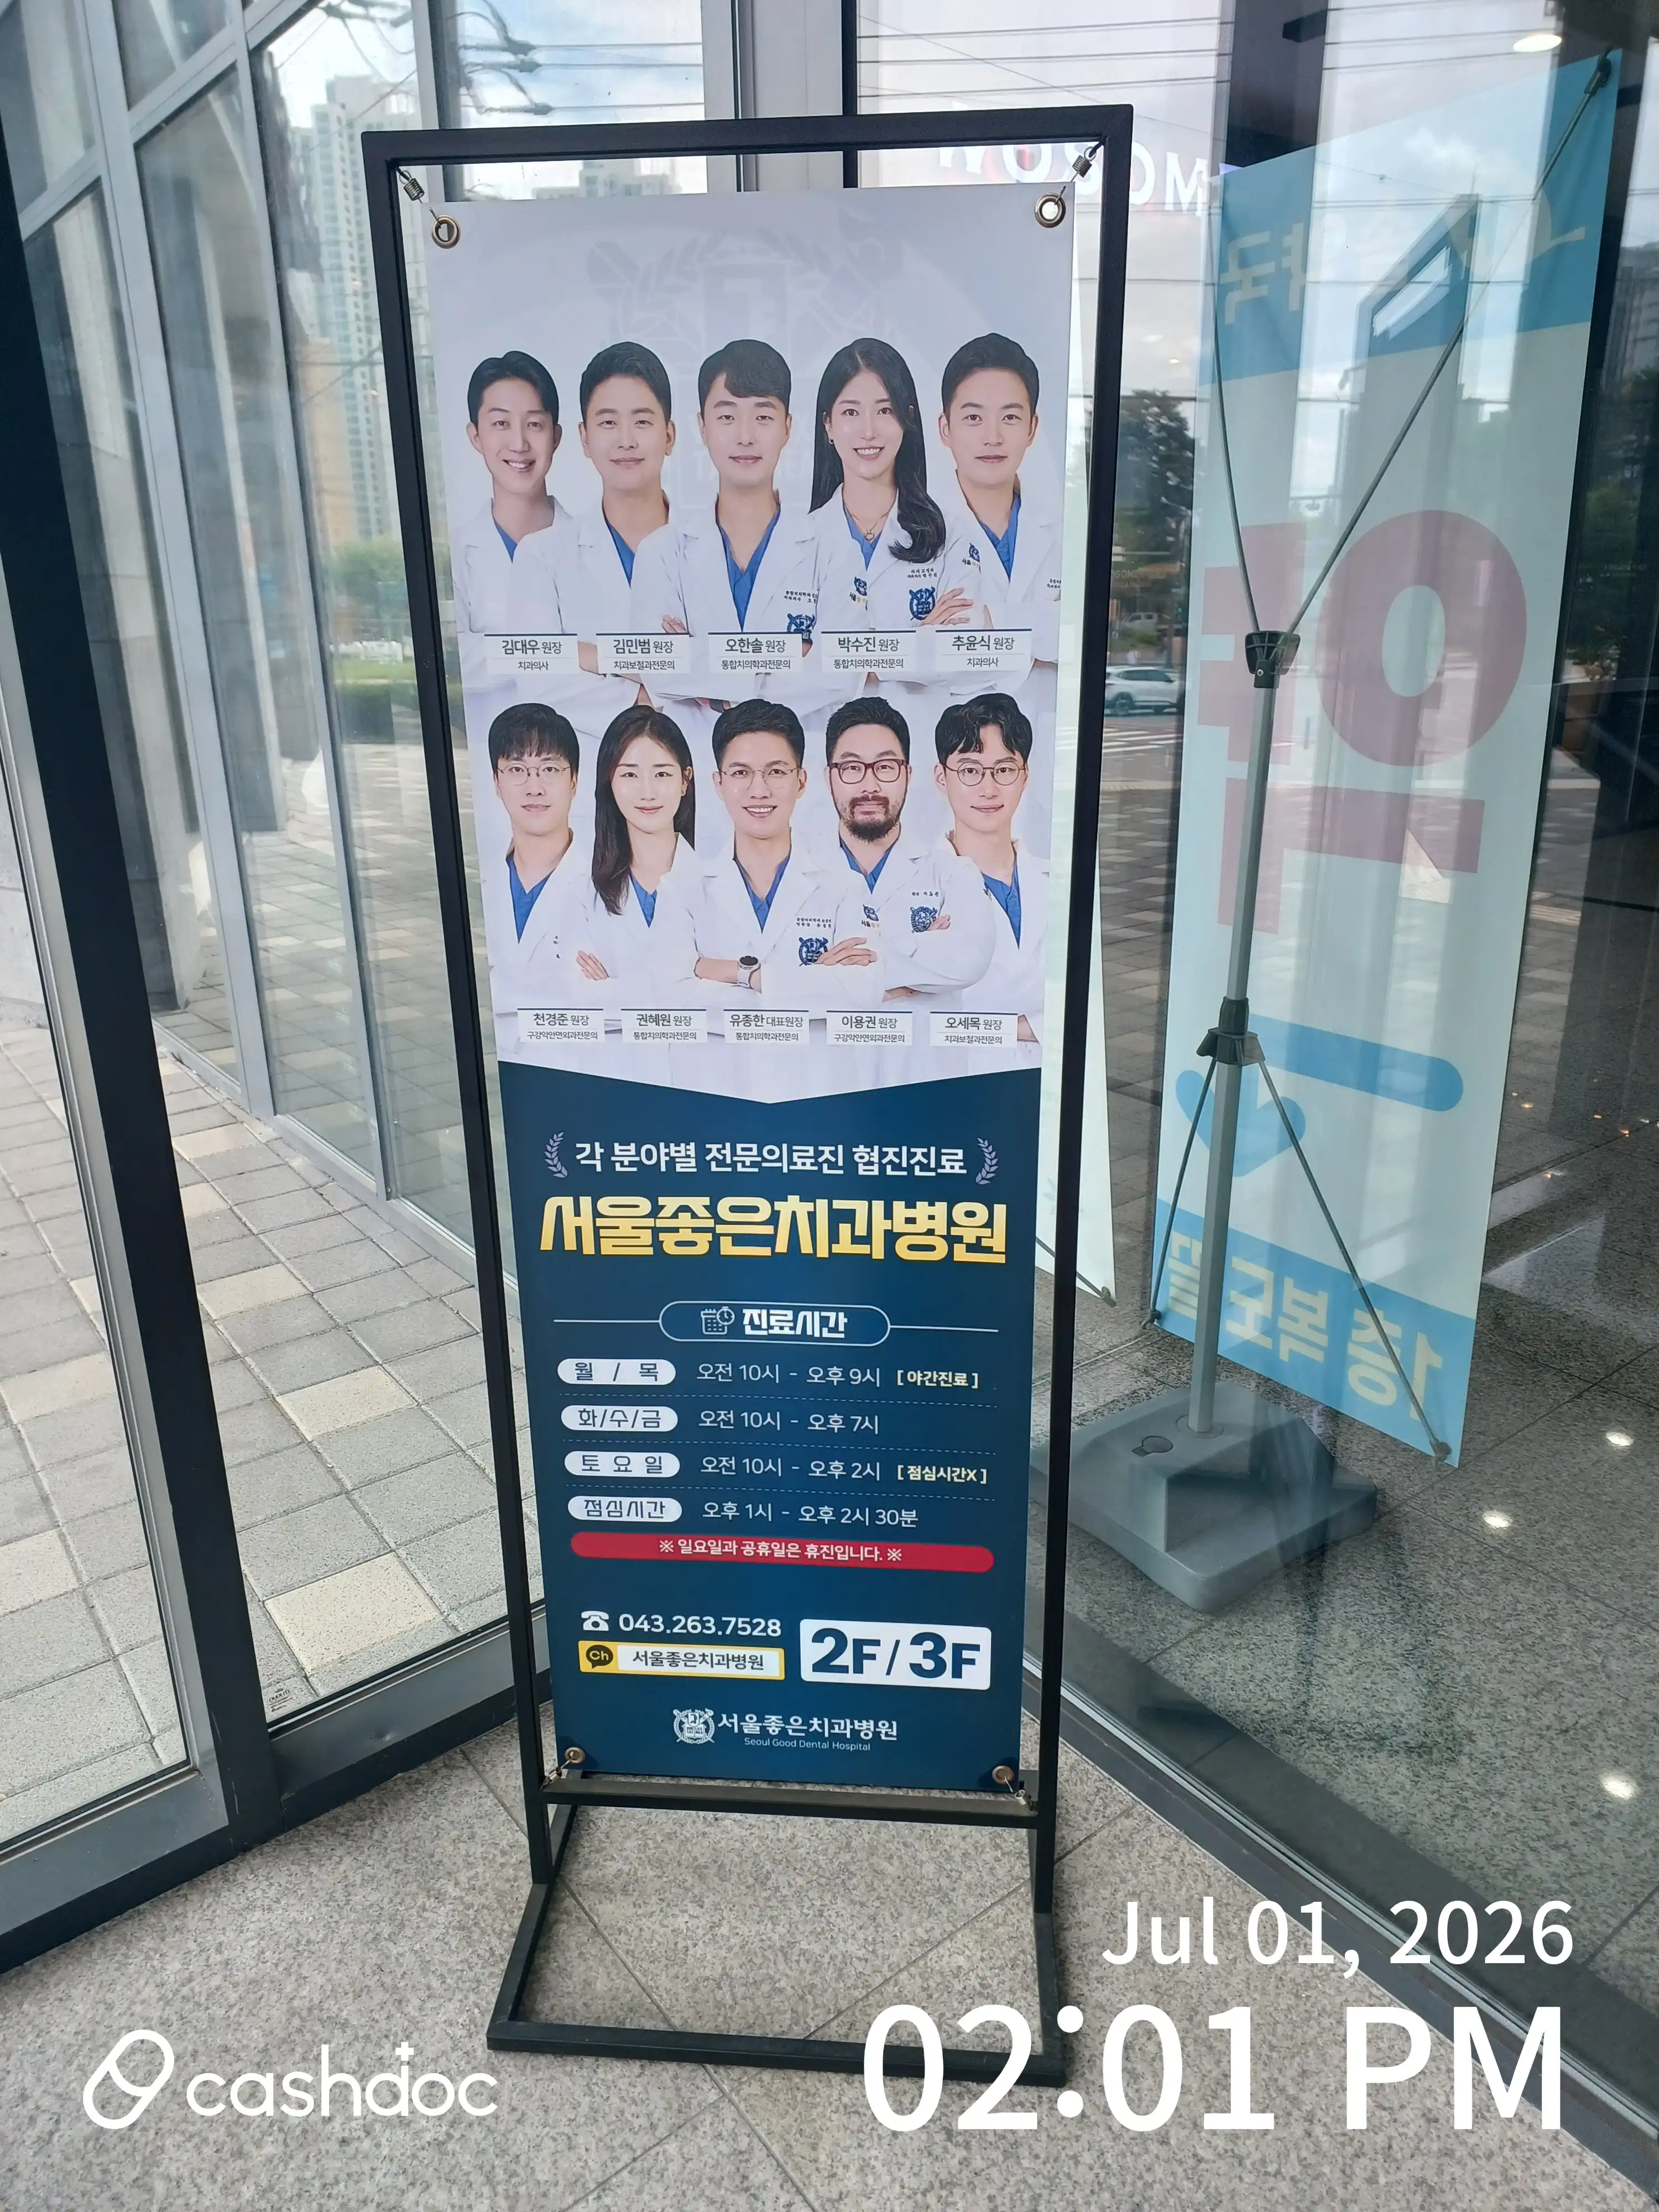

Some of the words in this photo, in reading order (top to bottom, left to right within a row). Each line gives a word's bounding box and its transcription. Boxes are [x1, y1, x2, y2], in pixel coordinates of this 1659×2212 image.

[503, 639, 540, 654] 김대우
[541, 642, 562, 654] 원장
[614, 639, 650, 654] 김민범
[653, 641, 674, 653] 원장
[725, 638, 763, 653] 오한솔
[765, 640, 786, 653] 원장
[838, 637, 875, 652] 박수진
[878, 639, 900, 651] 원장
[952, 635, 990, 651] 추윤식
[993, 638, 1015, 650] 원장
[518, 661, 549, 670] 치과의사
[614, 660, 675, 670] 치과보철과전문의
[722, 660, 790, 670] 통합치의학과전문의
[833, 659, 903, 669] 통합치의학과전문의
[967, 658, 999, 667] 치과의사
[534, 1013, 568, 1026] 천경준
[570, 1015, 589, 1025] 원장
[637, 1014, 671, 1026] 권혜원
[673, 1016, 692, 1026] 원장
[730, 1014, 765, 1027] 유종한
[766, 1016, 804, 1027] 대표원장
[842, 1016, 876, 1029] 이용권
[878, 1018, 898, 1029] 원장
[945, 1017, 981, 1030] 오세목
[983, 1020, 1003, 1030] 원장
[735, 1032, 798, 1041] 통합치의학과전문의
[834, 1034, 905, 1042] 구강악안면외과전문의
[945, 1035, 1001, 1044] 치과보철과전문의
[576, 1142, 604, 1171] 각
[611, 1142, 697, 1172] 분야별
[706, 1142, 843, 1174] 전문의료진
[852, 1145, 967, 1176] 협진진료
[540, 1195, 1006, 1263] 서울좋은치과병원
[743, 1306, 849, 1338] 진료시간
[575, 1363, 593, 1380] 월
[639, 1363, 658, 1381] 목
[697, 1363, 732, 1381] 오전
[739, 1364, 779, 1383] 10시
[807, 1366, 845, 1385] 오후
[849, 1368, 879, 1387] 9시
[578, 1408, 660, 1428] 화/수/금
[699, 1410, 734, 1428] 오전
[741, 1412, 780, 1430] 10시
[808, 1413, 846, 1433] 오후
[851, 1416, 878, 1434] 7시
[701, 1457, 735, 1474] 오전
[743, 1458, 781, 1477] 10시
[808, 1460, 846, 1479] 오후
[852, 1462, 879, 1480] 2시
[583, 1500, 665, 1520] 점심시간
[703, 1501, 739, 1520] 오후
[745, 1504, 771, 1521] 1시
[799, 1506, 836, 1524] 오후
[841, 1507, 868, 1526] 2시
[875, 1510, 918, 1527] 30분
[678, 1539, 738, 1555] 일요일과
[740, 1541, 801, 1557] 공휴일은
[805, 1543, 882, 1561] 휴진입니다.
[619, 1614, 781, 1636] 043.263.7528
[588, 1651, 608, 1662] Ch
[633, 1651, 763, 1670] 서울좋은치과병원
[718, 1714, 896, 1743] 서울좋은치과병원
[744, 1738, 770, 1746] Seoul
[773, 1739, 796, 1747] Good
[800, 1740, 829, 1749] Dental
[833, 1742, 870, 1751] Hospital
